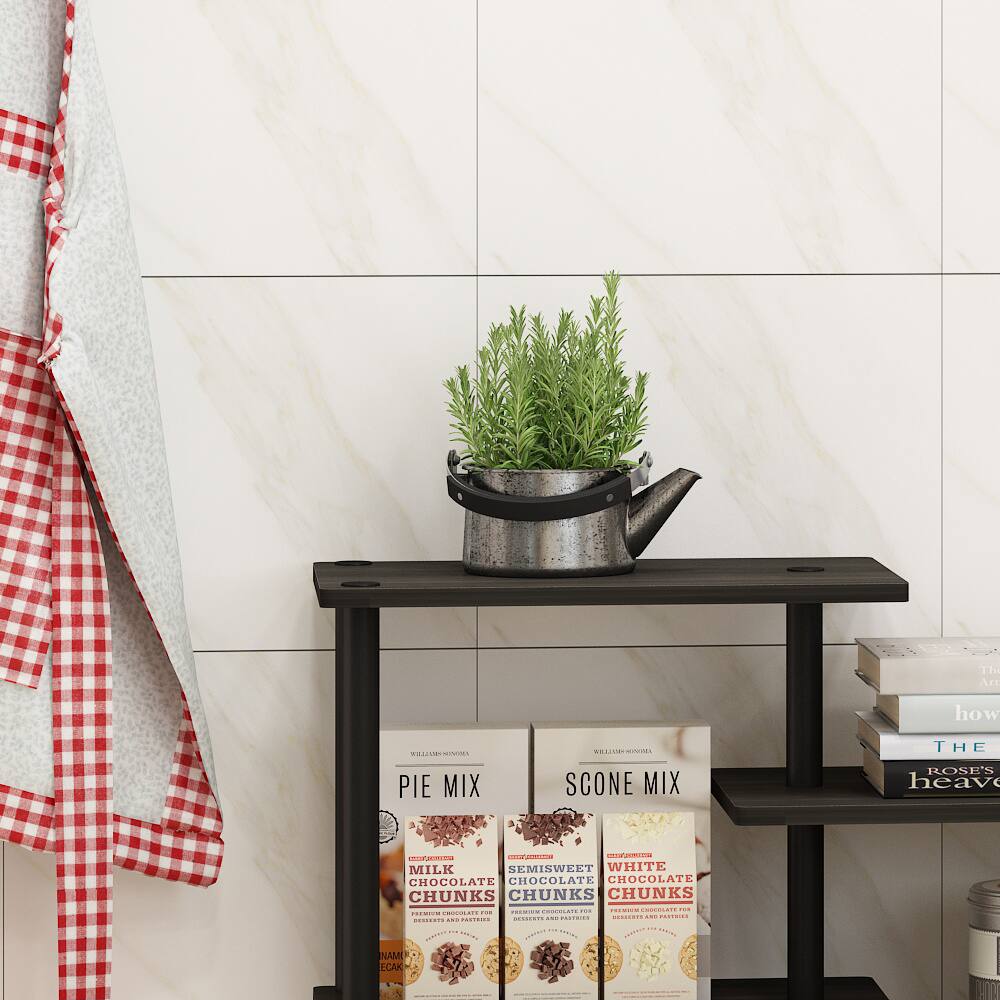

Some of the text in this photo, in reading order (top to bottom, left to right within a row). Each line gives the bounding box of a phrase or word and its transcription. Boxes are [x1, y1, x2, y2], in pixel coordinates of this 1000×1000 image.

[955, 704, 1000, 722] how
[934, 740, 985, 753] THE
[927, 765, 995, 776] ROSE'S
[399, 773, 480, 798] PIE MIX
[565, 770, 680, 796] SCONE MIX
[409, 864, 454, 875] MILK
[508, 864, 594, 873] SEMISWEET
[607, 861, 666, 872] WHITE
[408, 877, 495, 887] CHOCOLATE
[508, 876, 594, 886] CHOCOLATE
[607, 874, 693, 884] CHOCOLATE
[408, 889, 495, 903] CHUNKS
[508, 888, 594, 902] CHUNKS
[607, 886, 694, 900] CHUNKS
